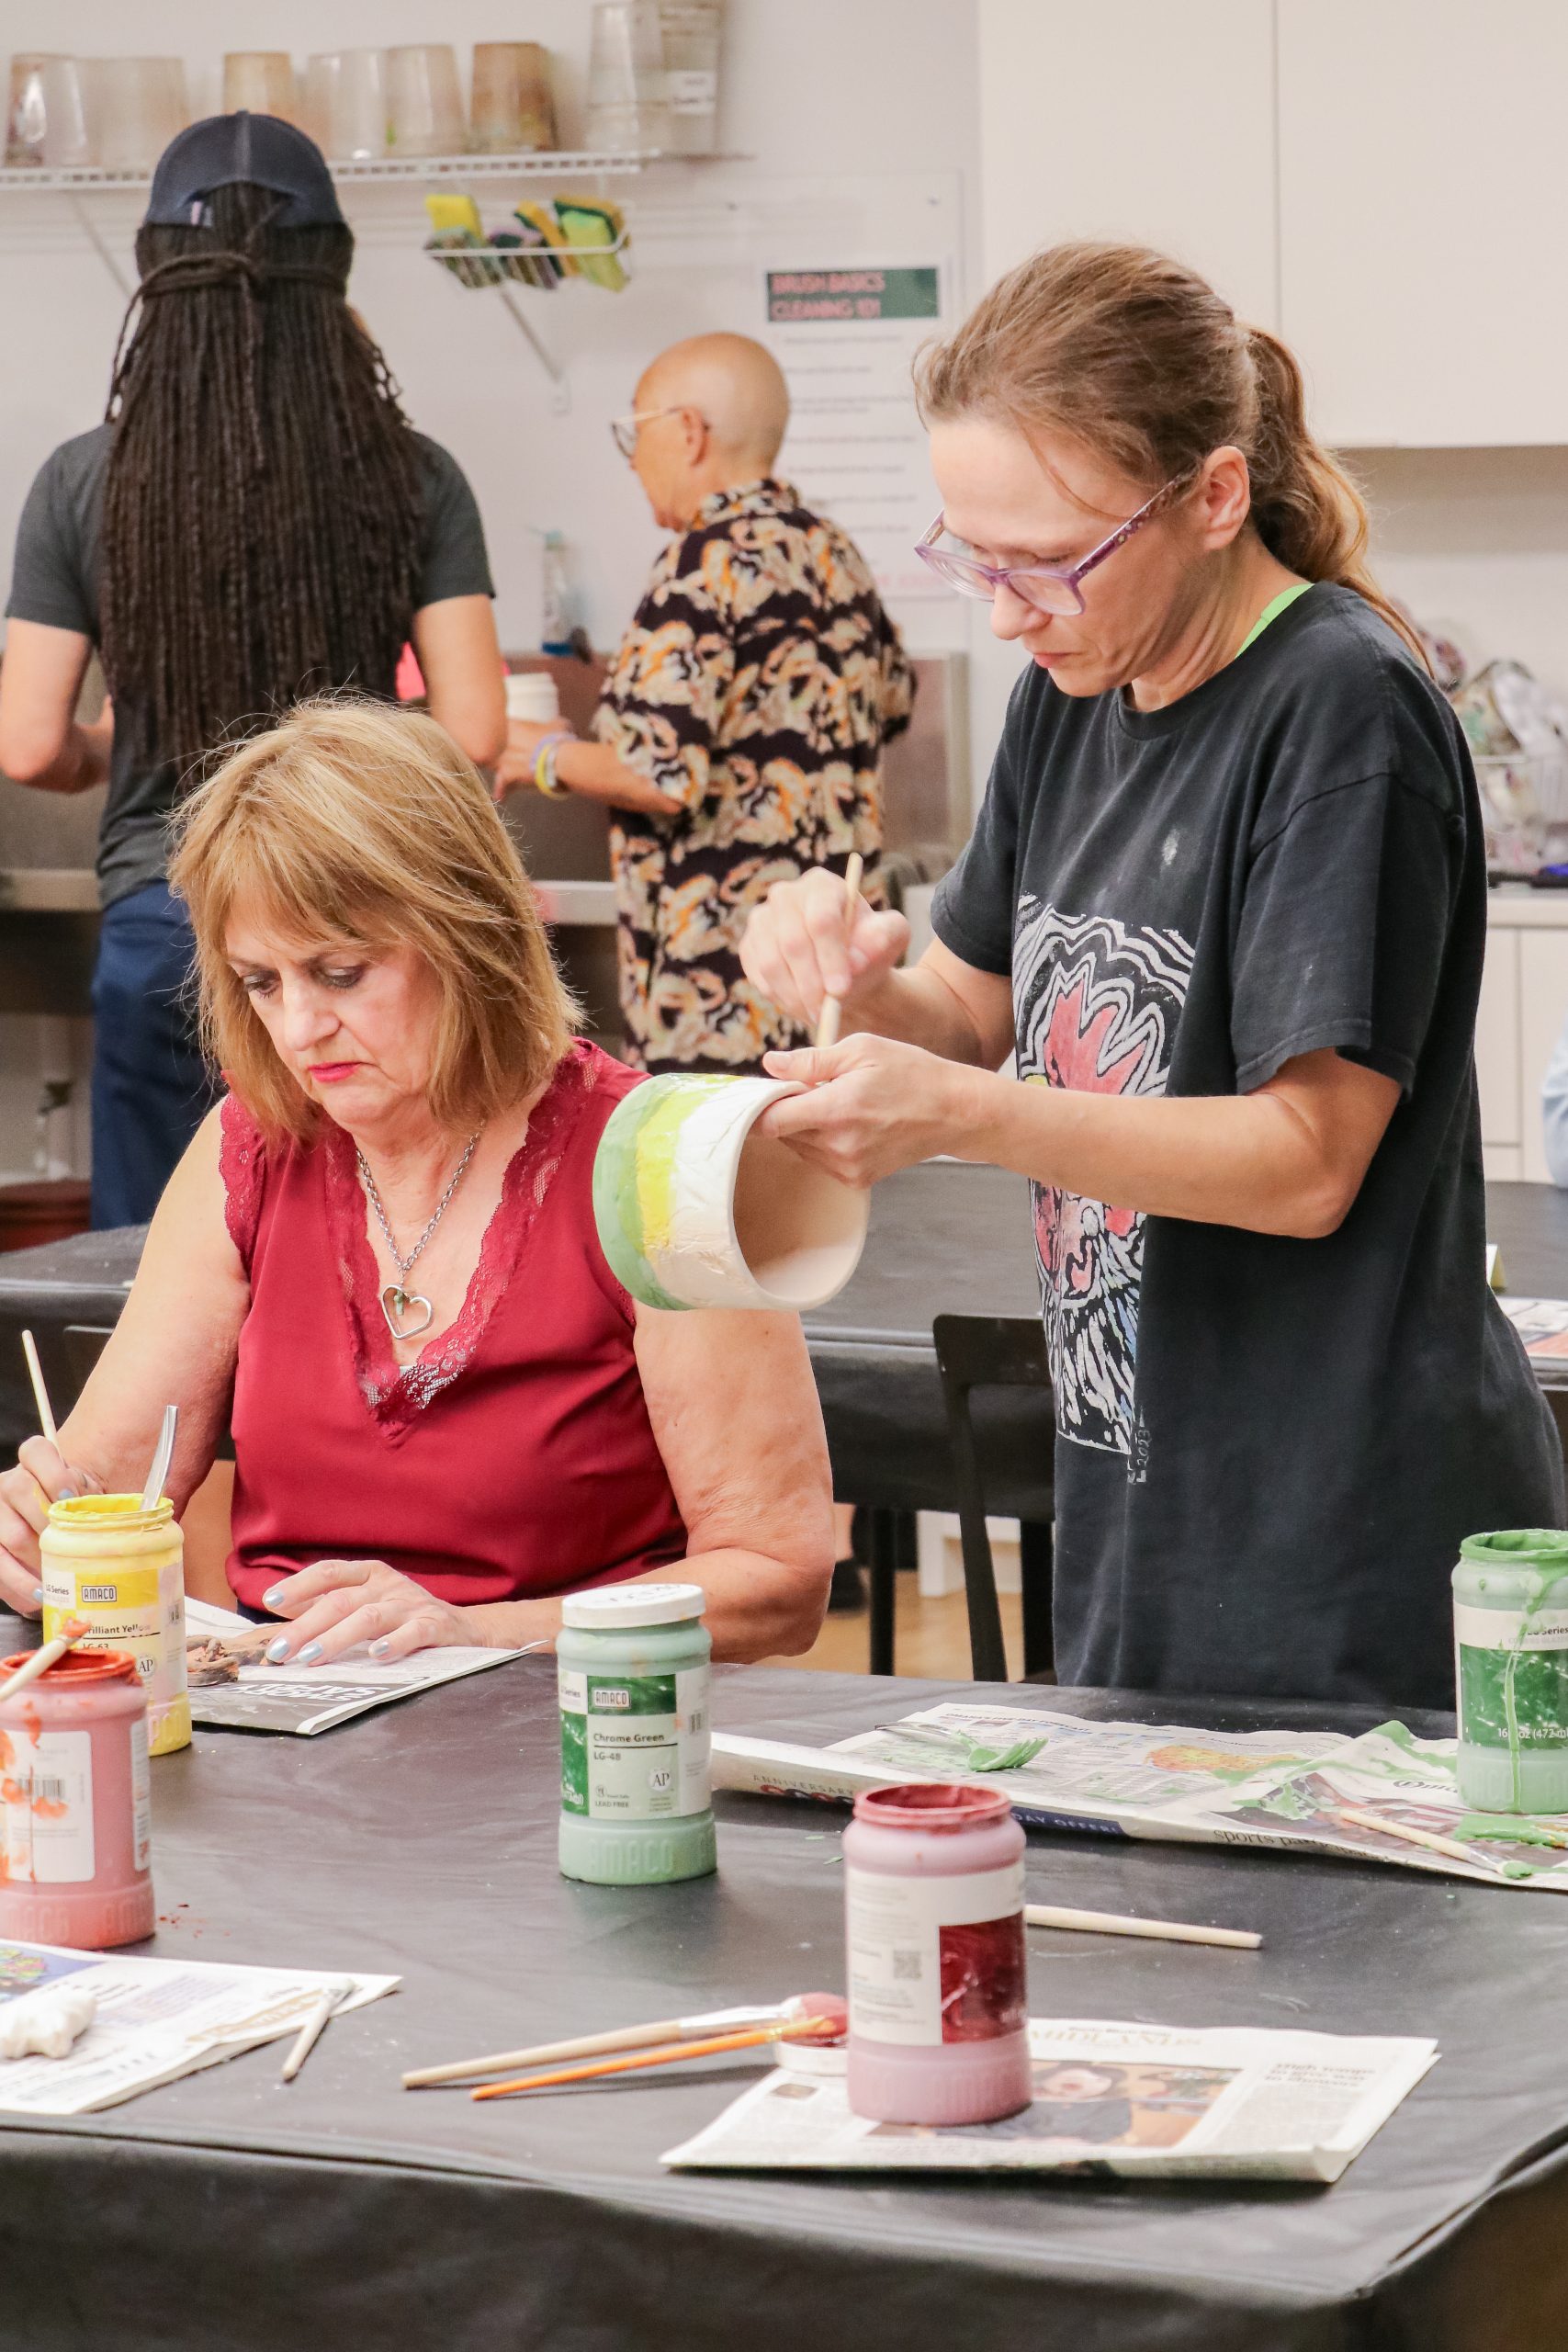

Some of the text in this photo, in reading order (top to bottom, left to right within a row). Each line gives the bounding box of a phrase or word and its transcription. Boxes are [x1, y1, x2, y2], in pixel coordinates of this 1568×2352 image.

[51, 1585, 69, 1596] Series
[84, 1588, 115, 1600] AMACO
[88, 1624, 120, 1634] rilliant
[139, 1659, 153, 1673] AP
[595, 1691, 628, 1705] AMACO
[593, 1733, 665, 1743] Chrome Green
[593, 1751, 621, 1760] LG-48
[652, 1772, 670, 1787] AP
[752, 1774, 853, 1796] ANNIVERSARY
[1213, 1828, 1275, 1846] sports
